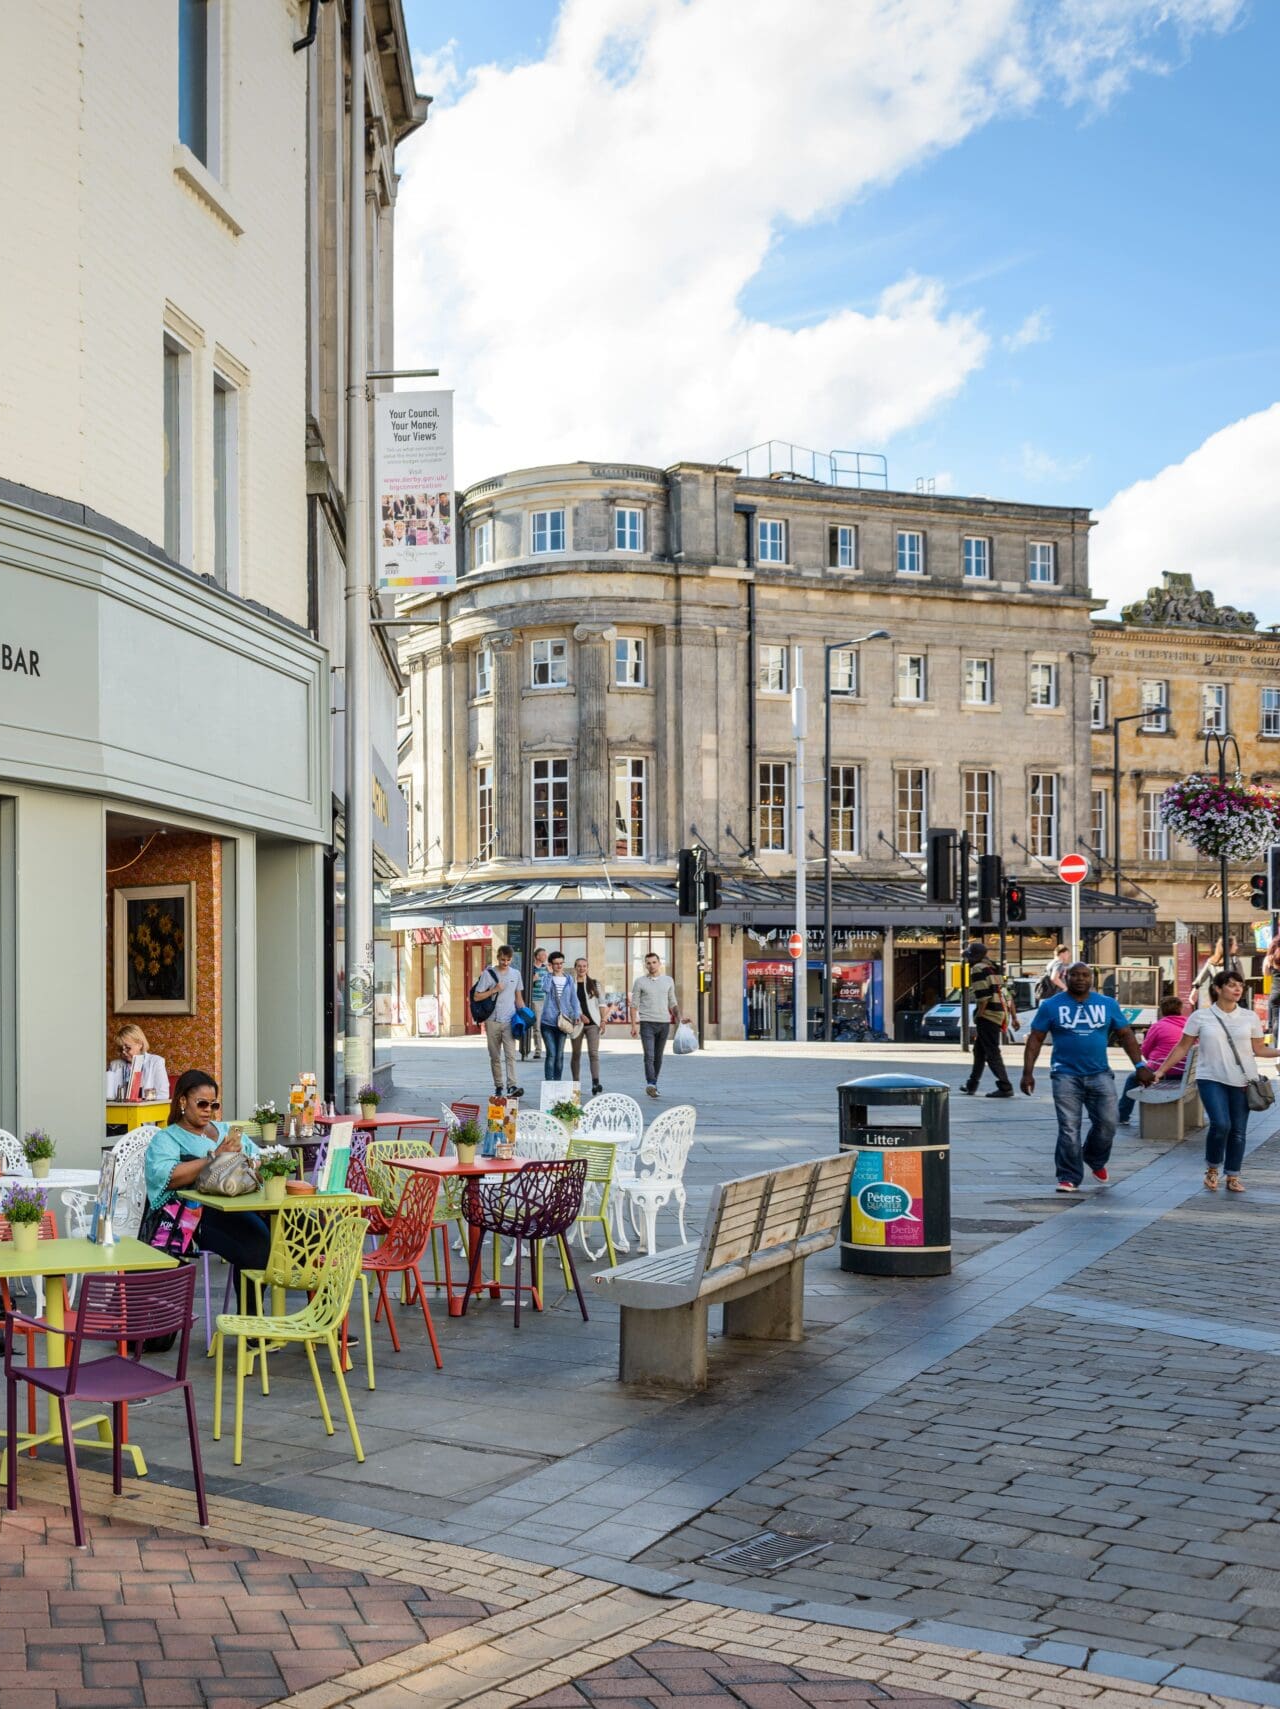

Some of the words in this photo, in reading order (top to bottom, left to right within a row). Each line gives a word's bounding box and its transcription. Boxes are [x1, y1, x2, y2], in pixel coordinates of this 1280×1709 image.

[389, 409, 406, 419] Your
[391, 421, 409, 431] Your
[393, 432, 410, 442] Your
[413, 432, 437, 441] Views
[1, 643, 41, 678] BAR
[779, 929, 826, 940] LIRTY
[832, 930, 878, 940] LIGHTS
[1058, 1004, 1106, 1029] RAW
[866, 1134, 901, 1145] Litter
[867, 1191, 902, 1203] Peters
[867, 1202, 902, 1210] QUARTER
[891, 1225, 920, 1235] Derby
